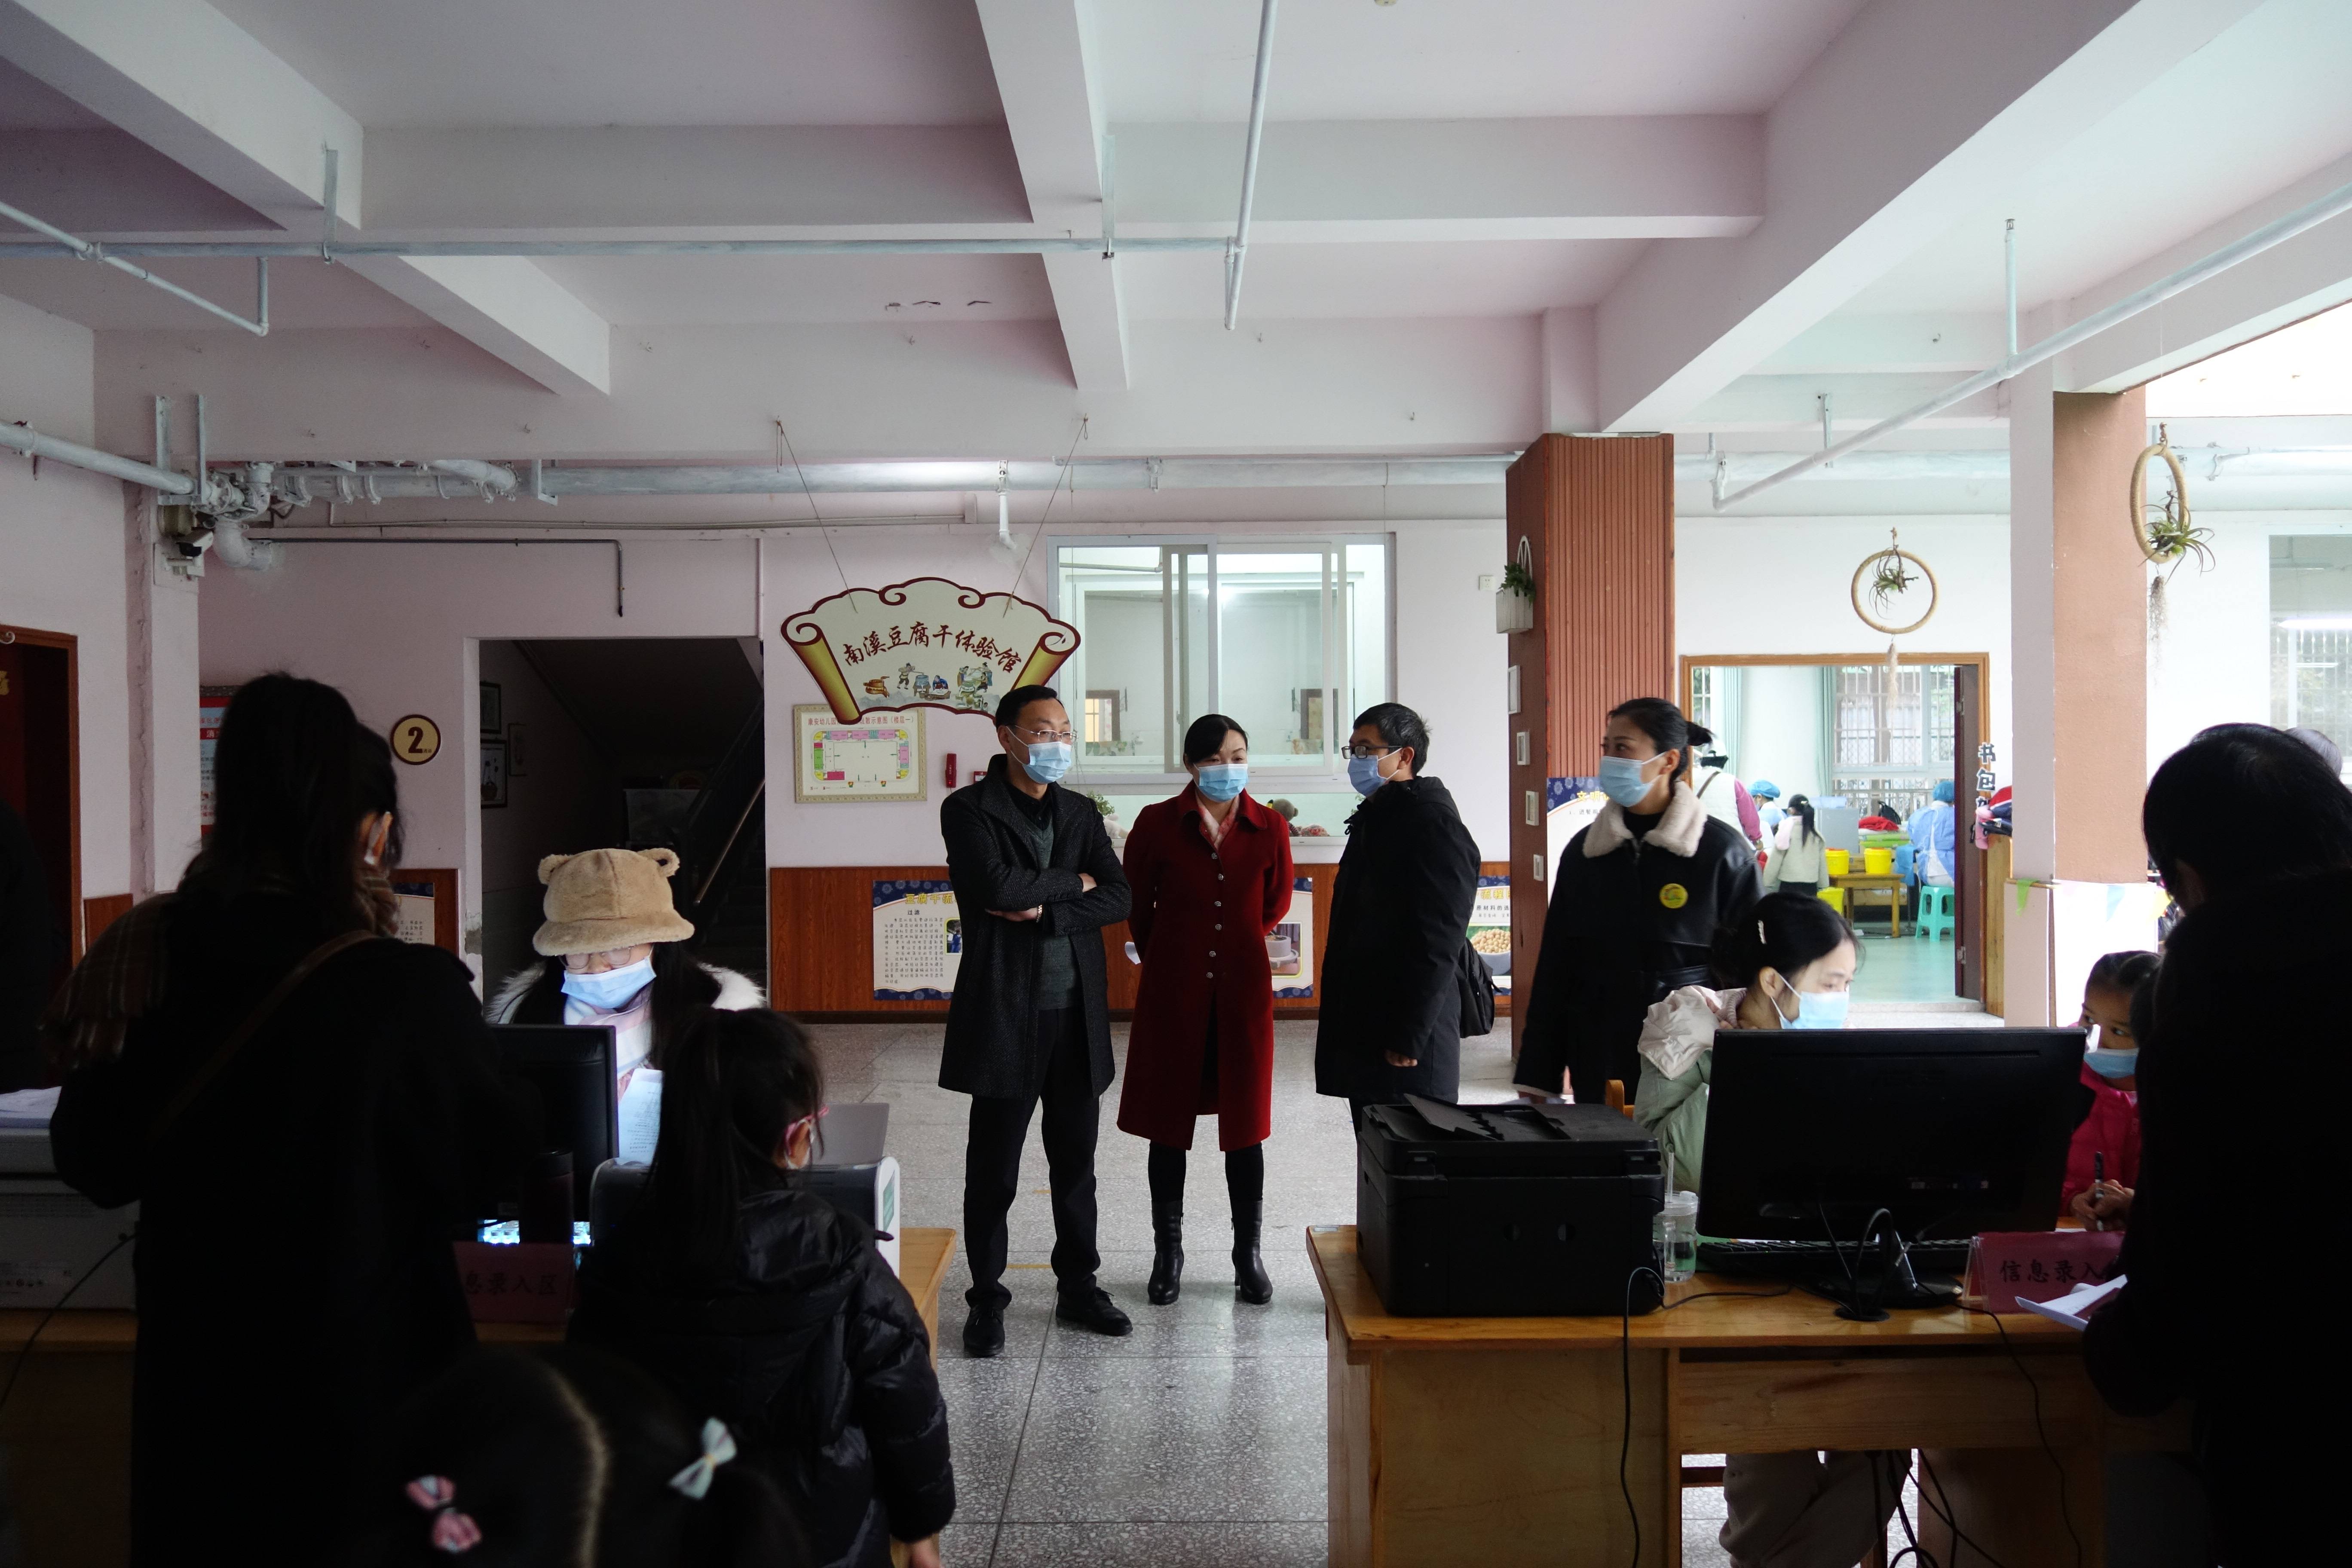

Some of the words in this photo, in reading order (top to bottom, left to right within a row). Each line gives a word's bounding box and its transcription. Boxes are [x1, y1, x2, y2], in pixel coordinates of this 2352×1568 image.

[843, 621, 1021, 673] 南溪豆腐干体验馆
[408, 726, 423, 753] 2
[905, 893, 957, 905] 豆腐干流
